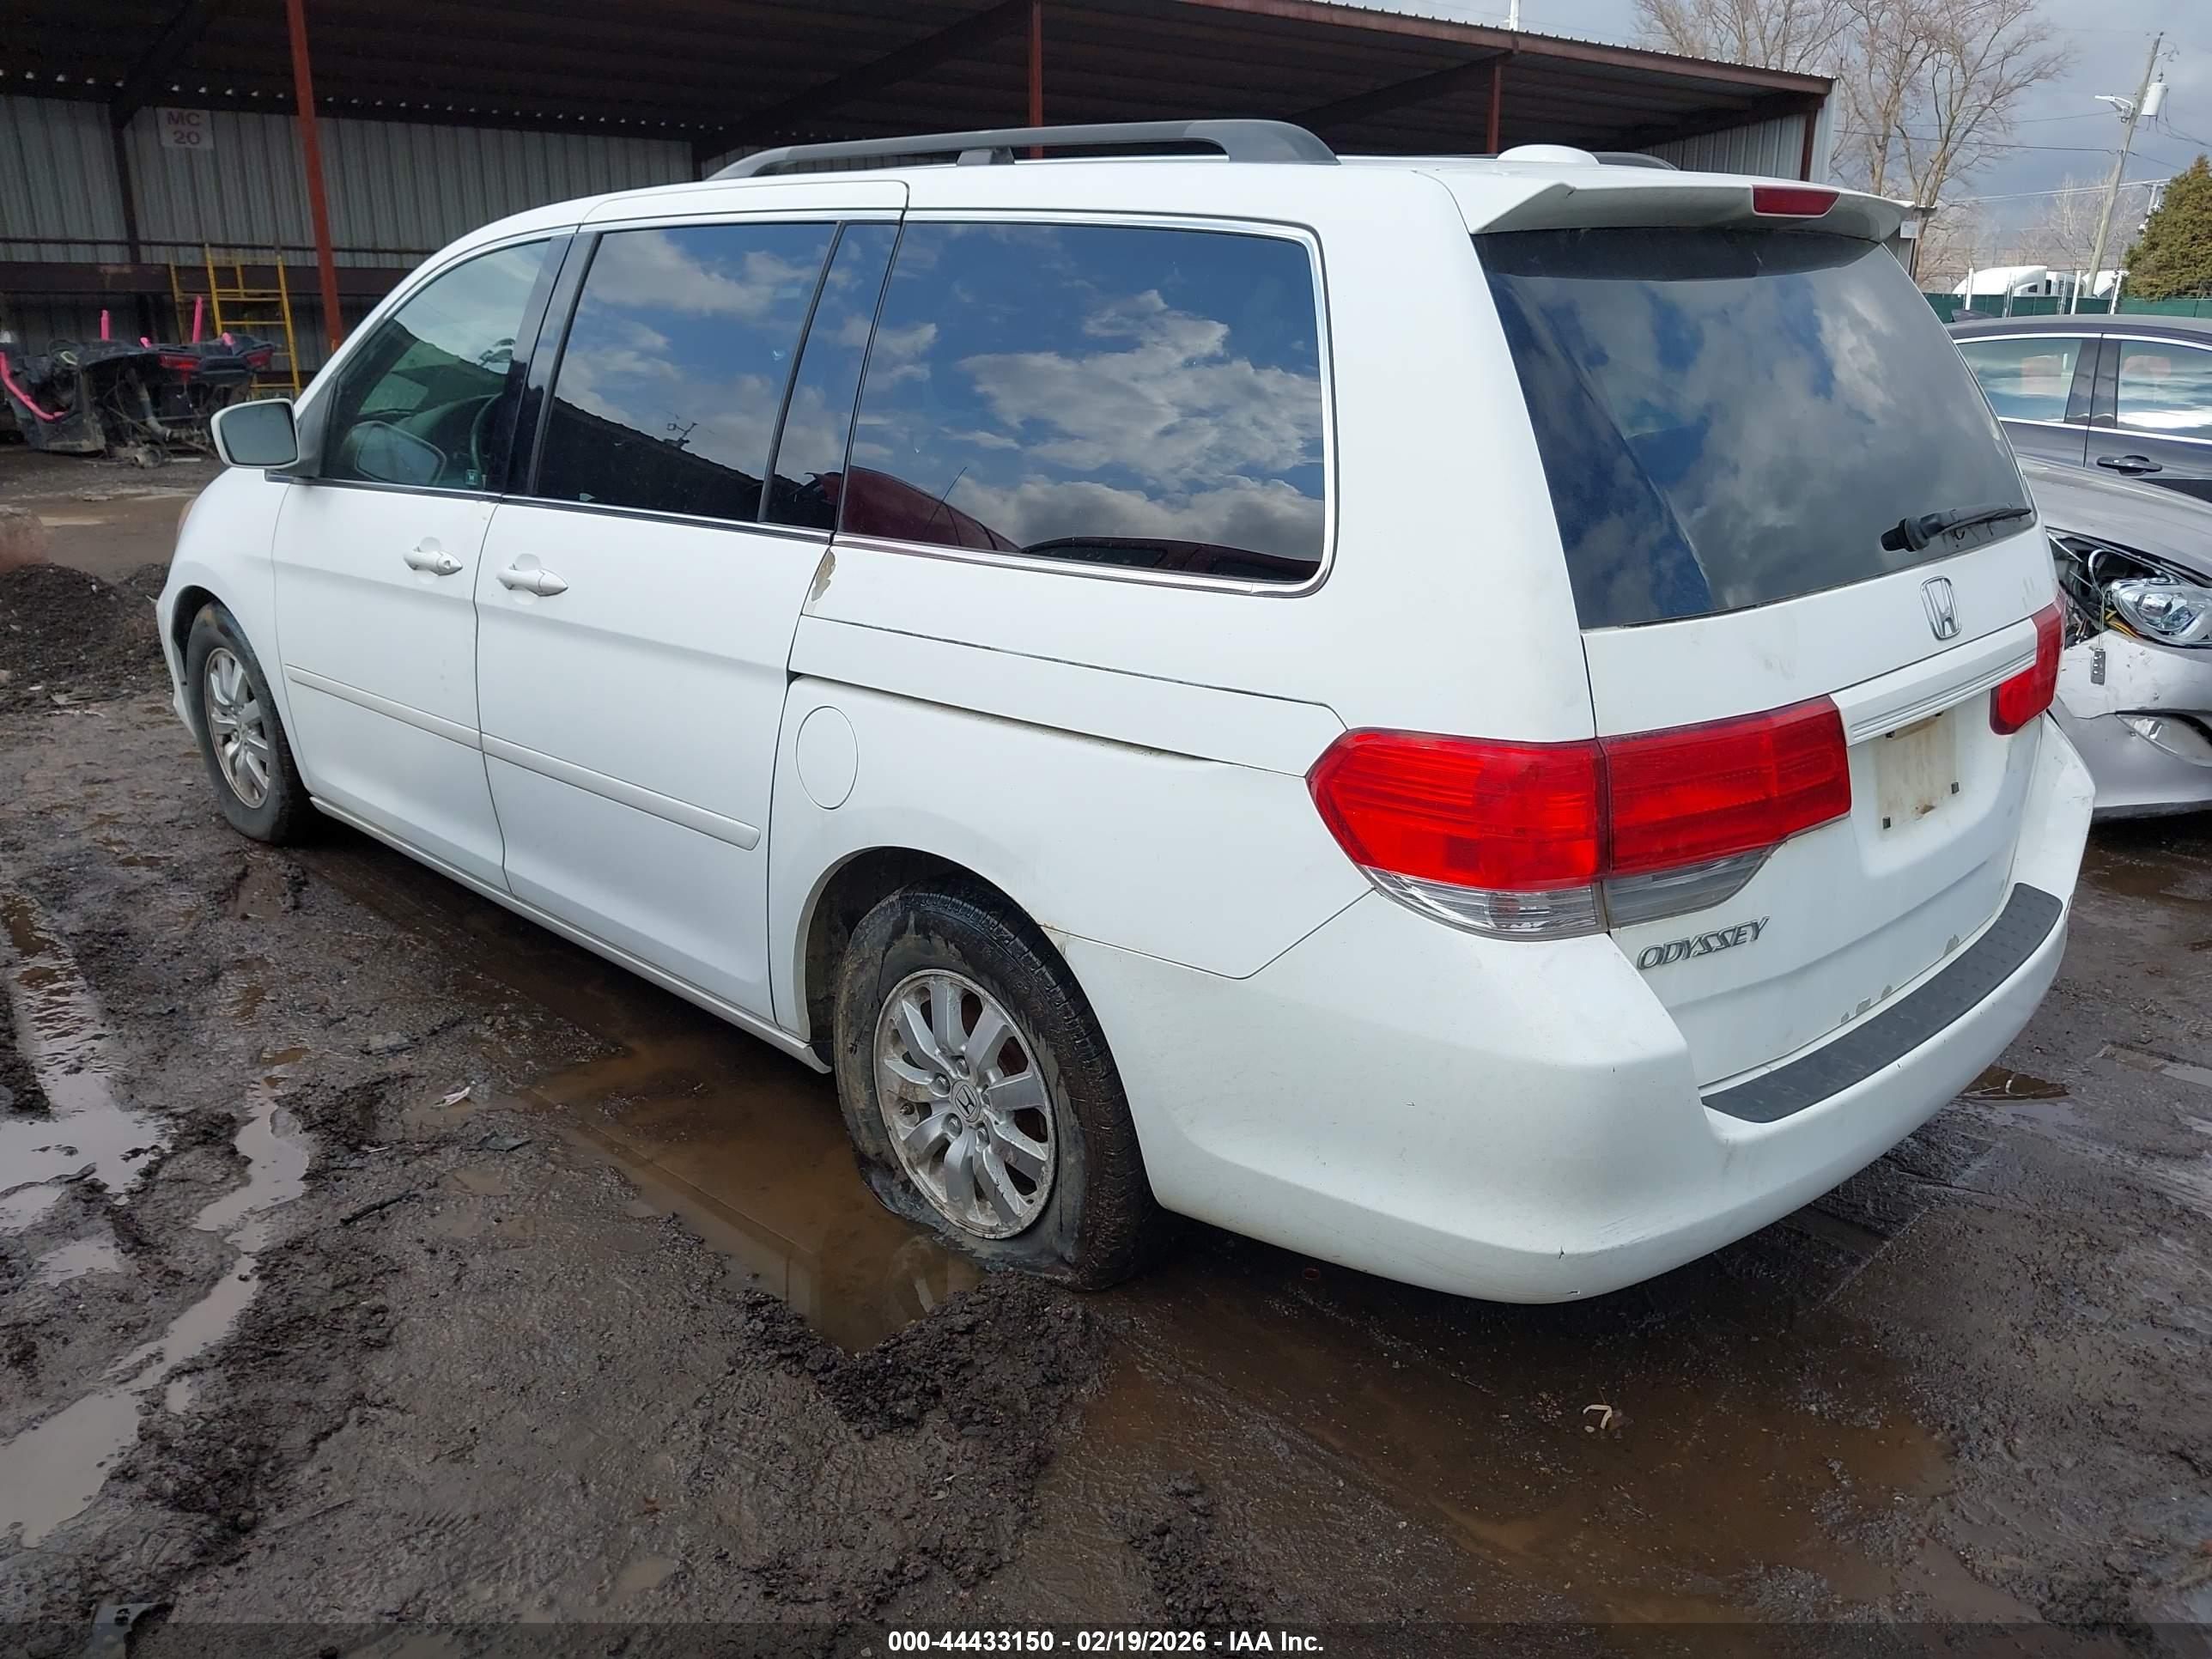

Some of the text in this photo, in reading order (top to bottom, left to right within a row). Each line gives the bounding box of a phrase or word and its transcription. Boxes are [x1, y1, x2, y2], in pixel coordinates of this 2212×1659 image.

[167, 110, 201, 126] MC
[173, 130, 201, 145] 20
[1637, 915, 1770, 969] ODYSSEY
